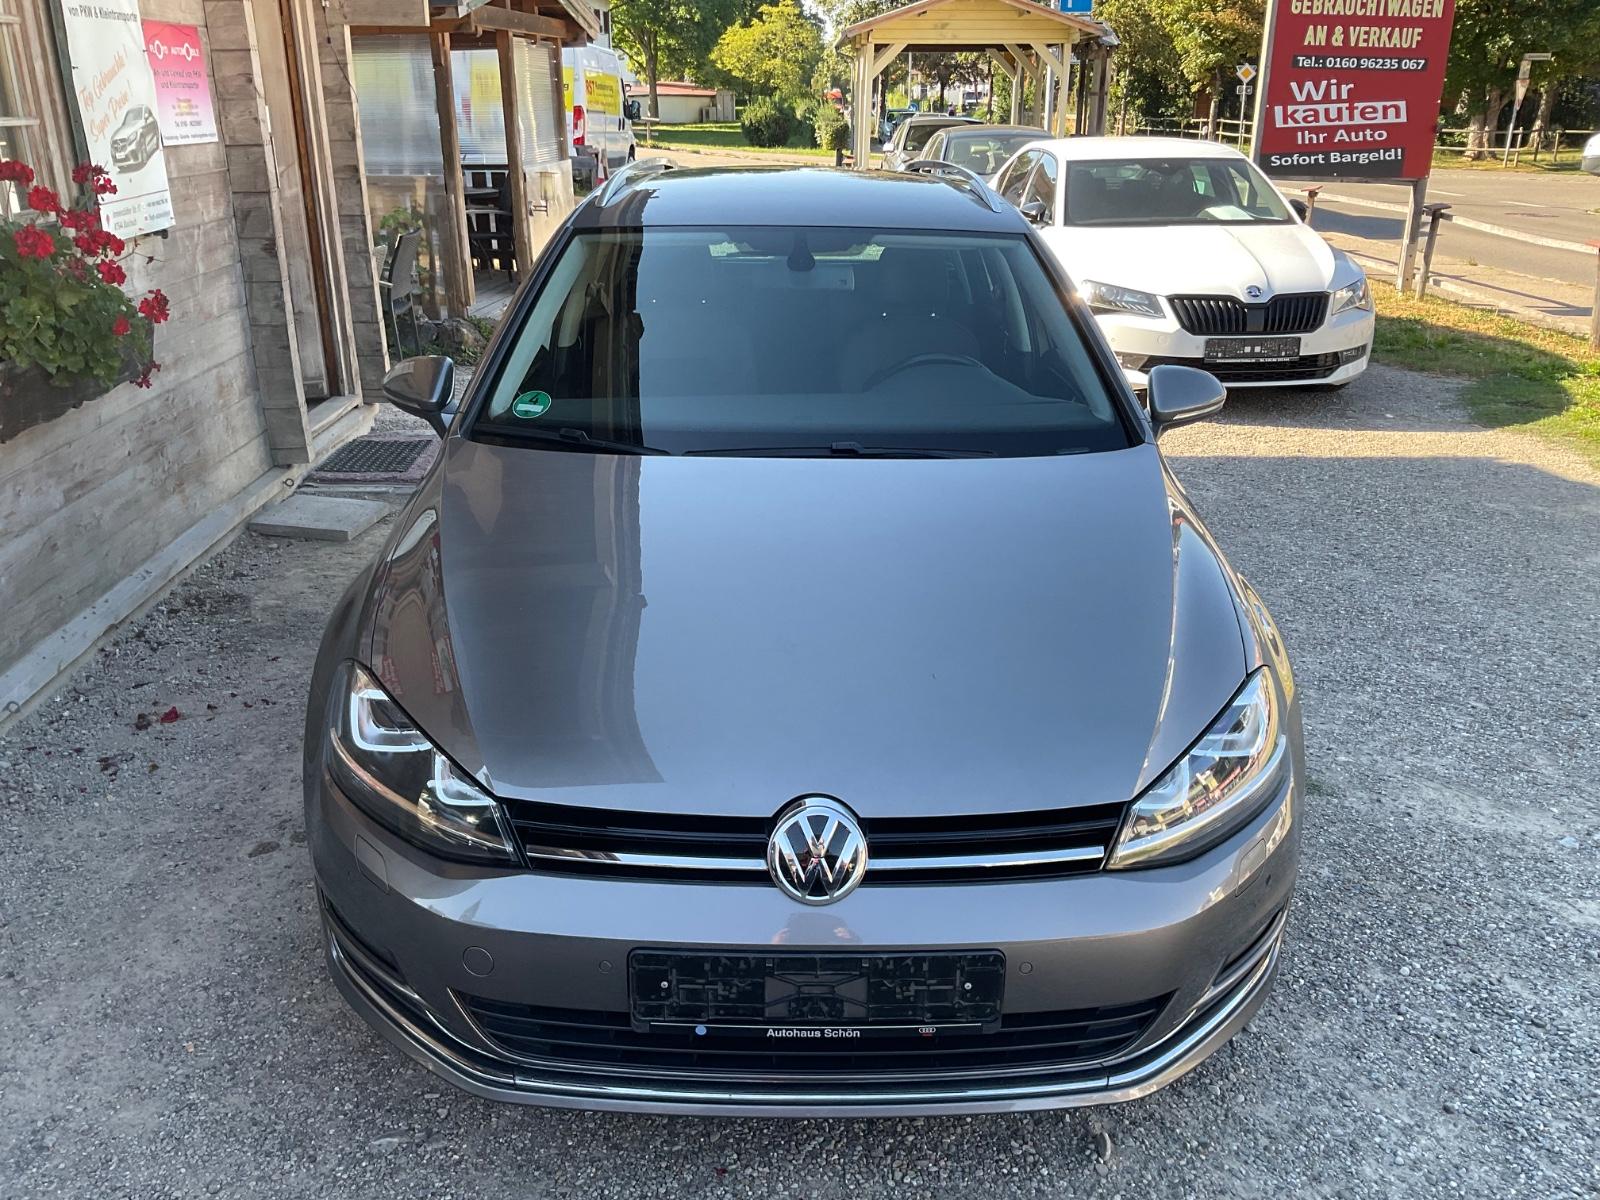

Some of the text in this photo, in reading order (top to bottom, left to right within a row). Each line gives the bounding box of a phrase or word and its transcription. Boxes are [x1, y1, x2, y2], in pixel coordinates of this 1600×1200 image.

[1291, 0, 1445, 18] GEBRAUCHTWAGEN
[1304, 25, 1424, 48] AN & VERKAUF
[1297, 56, 1426, 70] Tel.: 0160 96235 067
[1290, 79, 1354, 102] Wir
[1281, 102, 1401, 125] kaufen
[1297, 128, 1388, 145] Ihr Auto
[1270, 148, 1402, 167] Sofort Bargeld!
[529, 392, 541, 404] 4
[766, 1028, 861, 1038] Autohaus Schön
